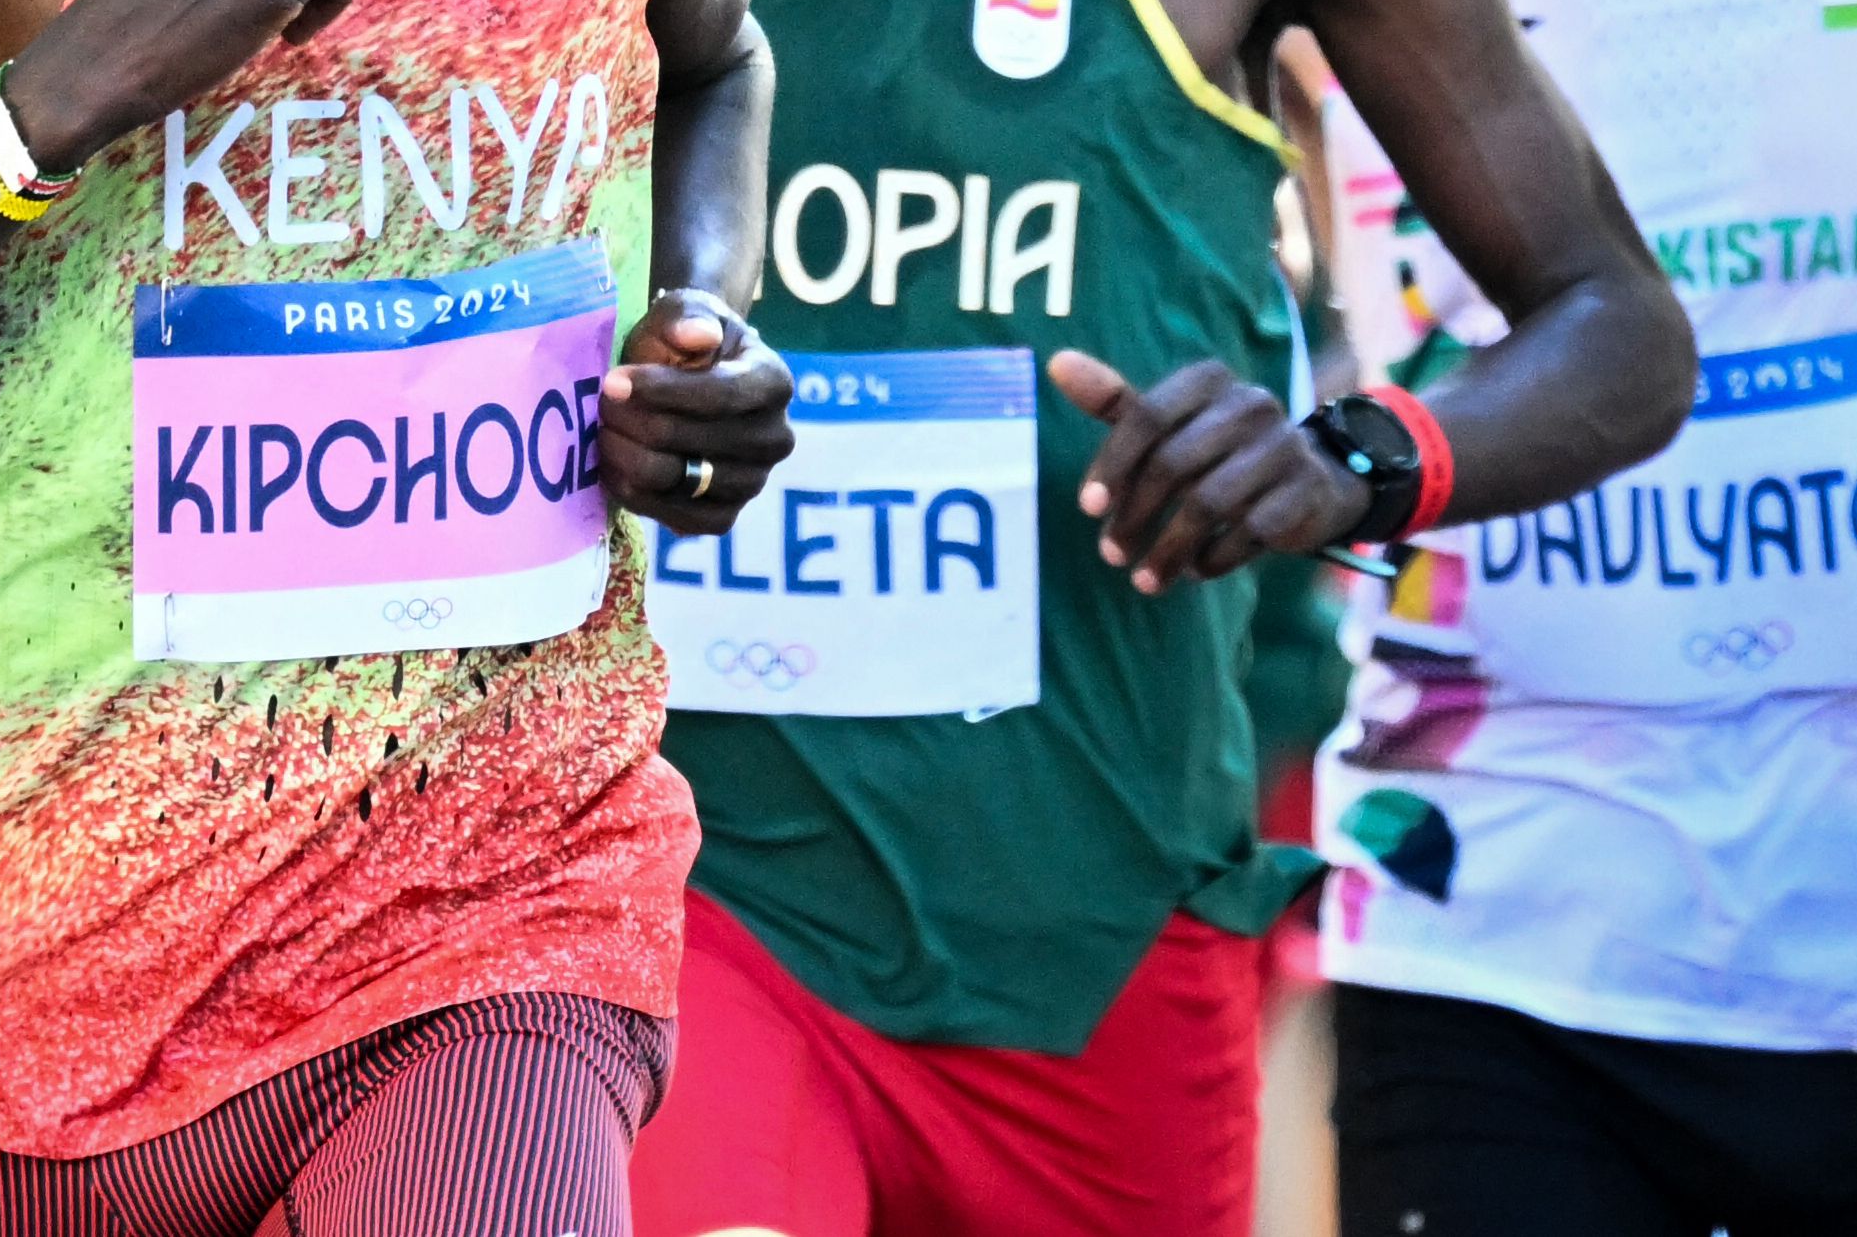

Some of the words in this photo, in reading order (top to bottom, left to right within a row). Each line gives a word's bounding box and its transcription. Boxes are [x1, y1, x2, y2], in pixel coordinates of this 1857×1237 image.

[164, 74, 608, 250] KENYA
[752, 163, 1081, 317] OPIA
[1656, 215, 1857, 285] KISTA
[284, 299, 416, 336] PARIS
[433, 279, 531, 325] 2024
[1726, 355, 1844, 400] 2024
[156, 375, 601, 535] KIPCHOGE
